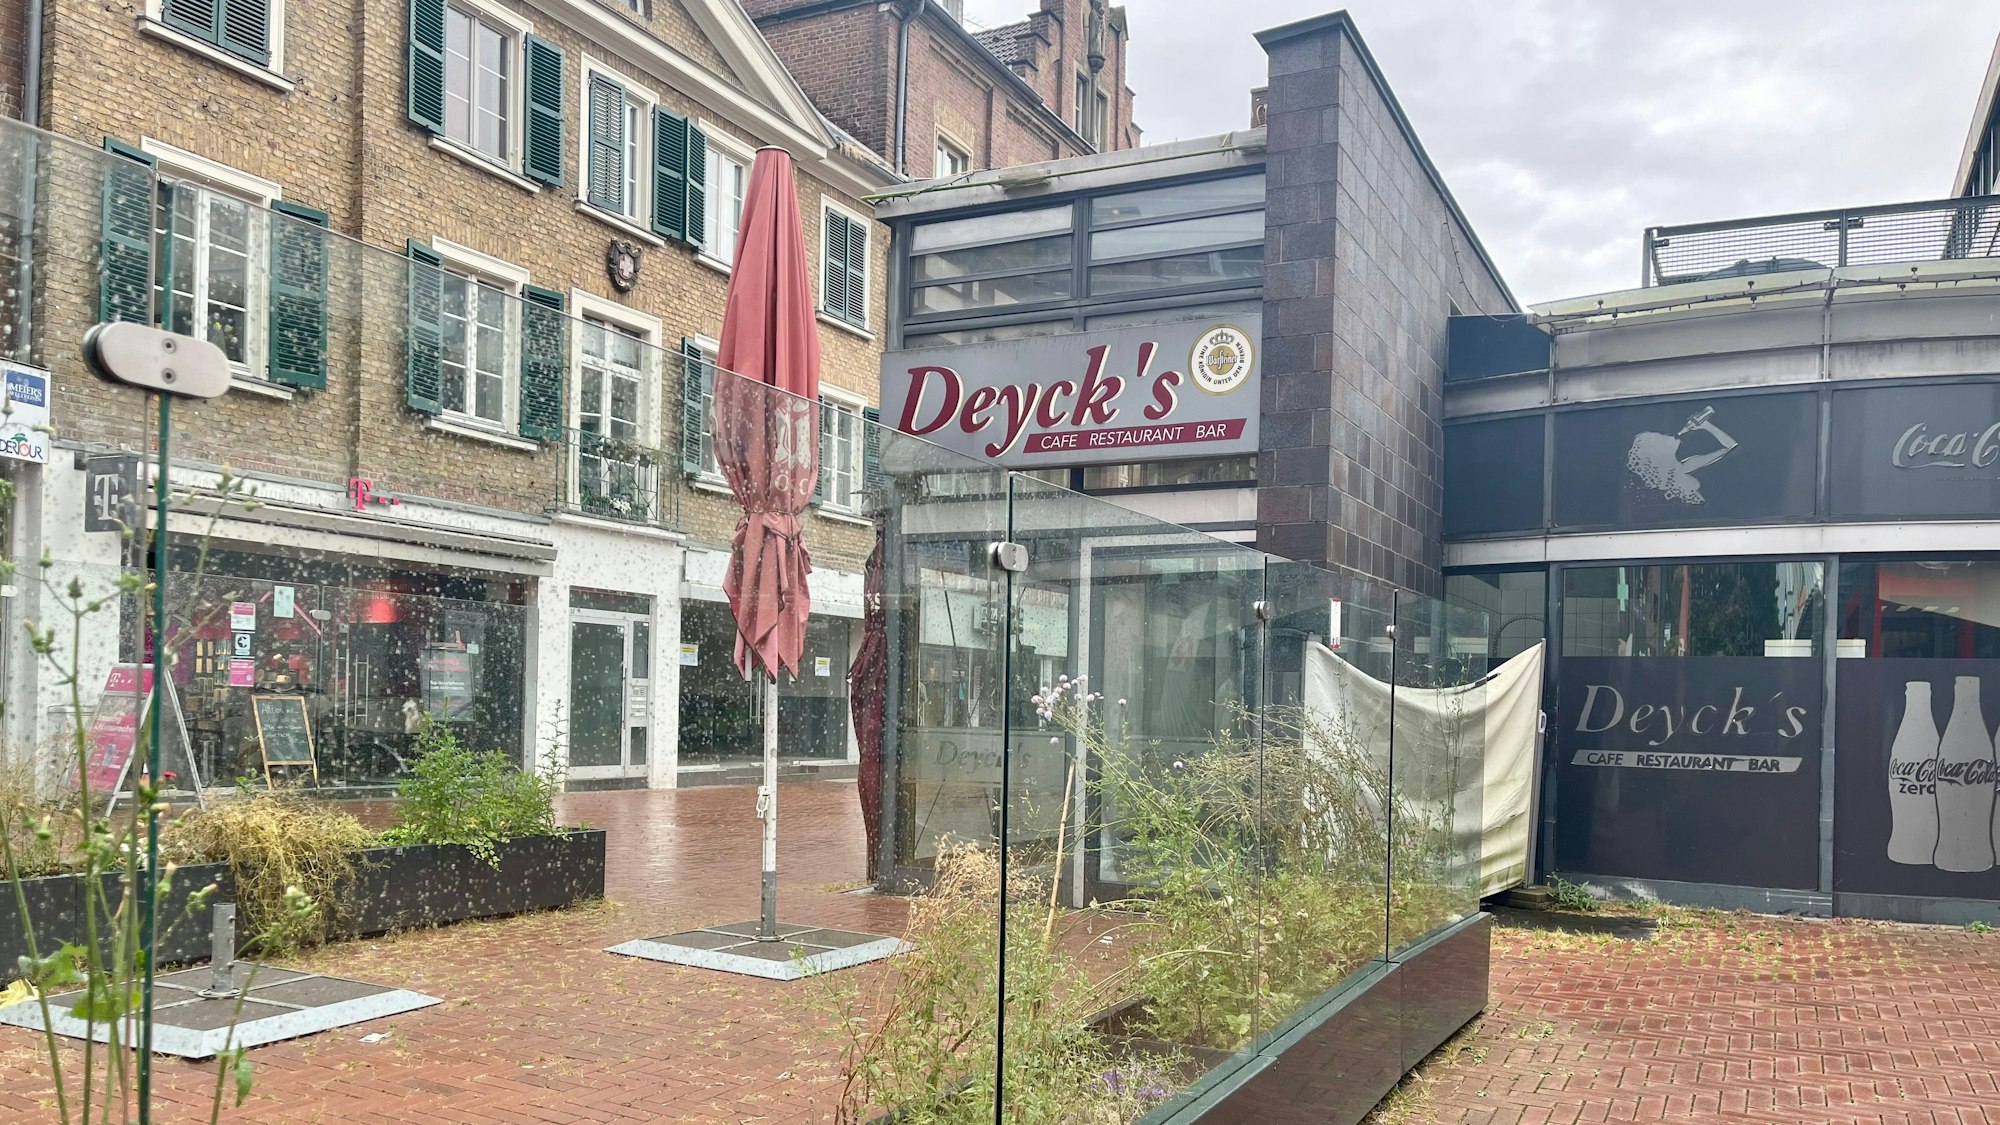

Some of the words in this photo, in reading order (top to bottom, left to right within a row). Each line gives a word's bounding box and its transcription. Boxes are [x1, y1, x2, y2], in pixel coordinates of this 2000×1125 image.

[1213, 376, 1233, 385] UNTER
[1232, 365, 1243, 378] DEN
[900, 341, 1185, 458] Deyck's
[0, 436, 43, 460] DERTOUR
[1040, 434, 1078, 449] CAFE
[1089, 426, 1184, 445] RESTAURANT
[1195, 424, 1227, 439] BAR
[1587, 753, 1624, 765] CAFE
[1636, 755, 1734, 769] RESTAURANT
[1748, 759, 1780, 771] BAR
